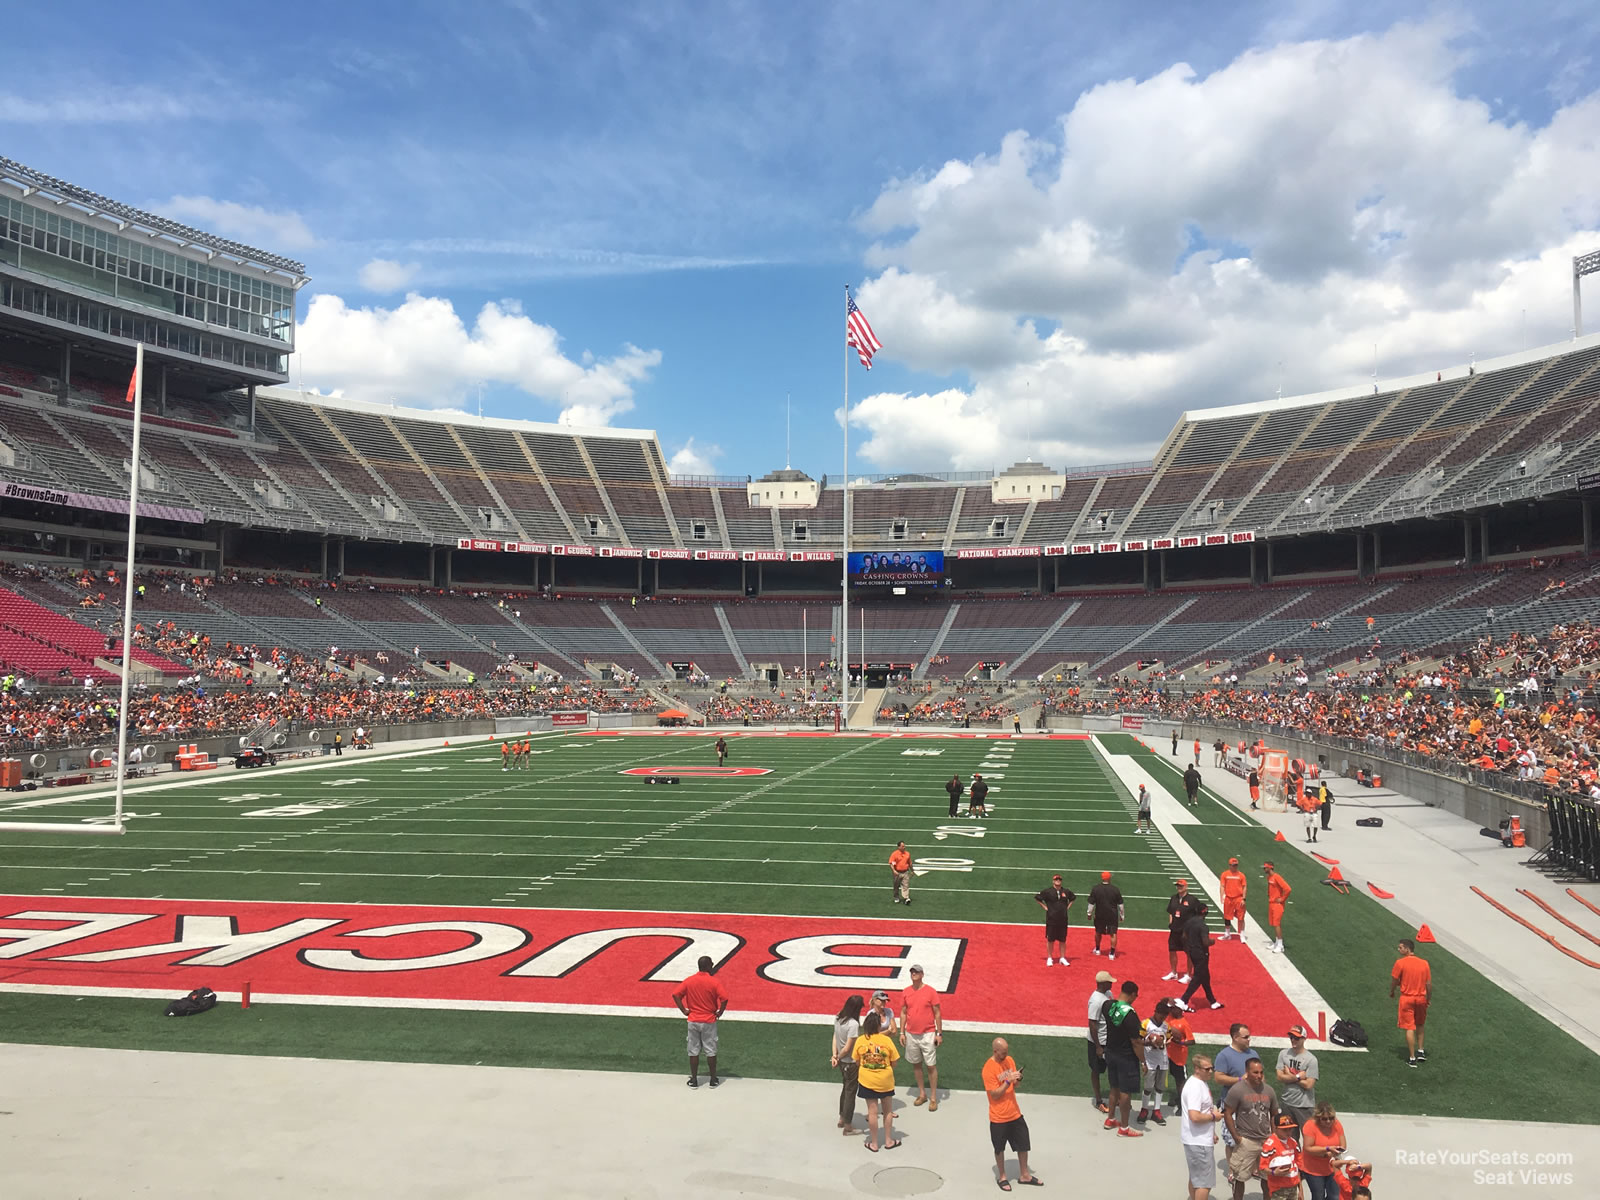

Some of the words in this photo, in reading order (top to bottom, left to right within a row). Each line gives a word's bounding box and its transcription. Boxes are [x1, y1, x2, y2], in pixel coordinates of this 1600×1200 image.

[5, 484, 69, 505] #BrownsCamp
[1233, 533, 1252, 542] 2014
[460, 540, 470, 549] 10
[474, 540, 497, 550] SMITH
[567, 546, 592, 555] GEORGE
[661, 550, 689, 559] CASSADY
[959, 549, 994, 559] NATIONAL
[997, 547, 1039, 557] CHAMPIONS
[709, 551, 736, 560] GRIFFIN
[757, 552, 784, 560] HARLEY
[806, 552, 831, 560] WILLIS
[1288, 1059, 1303, 1070] THE
